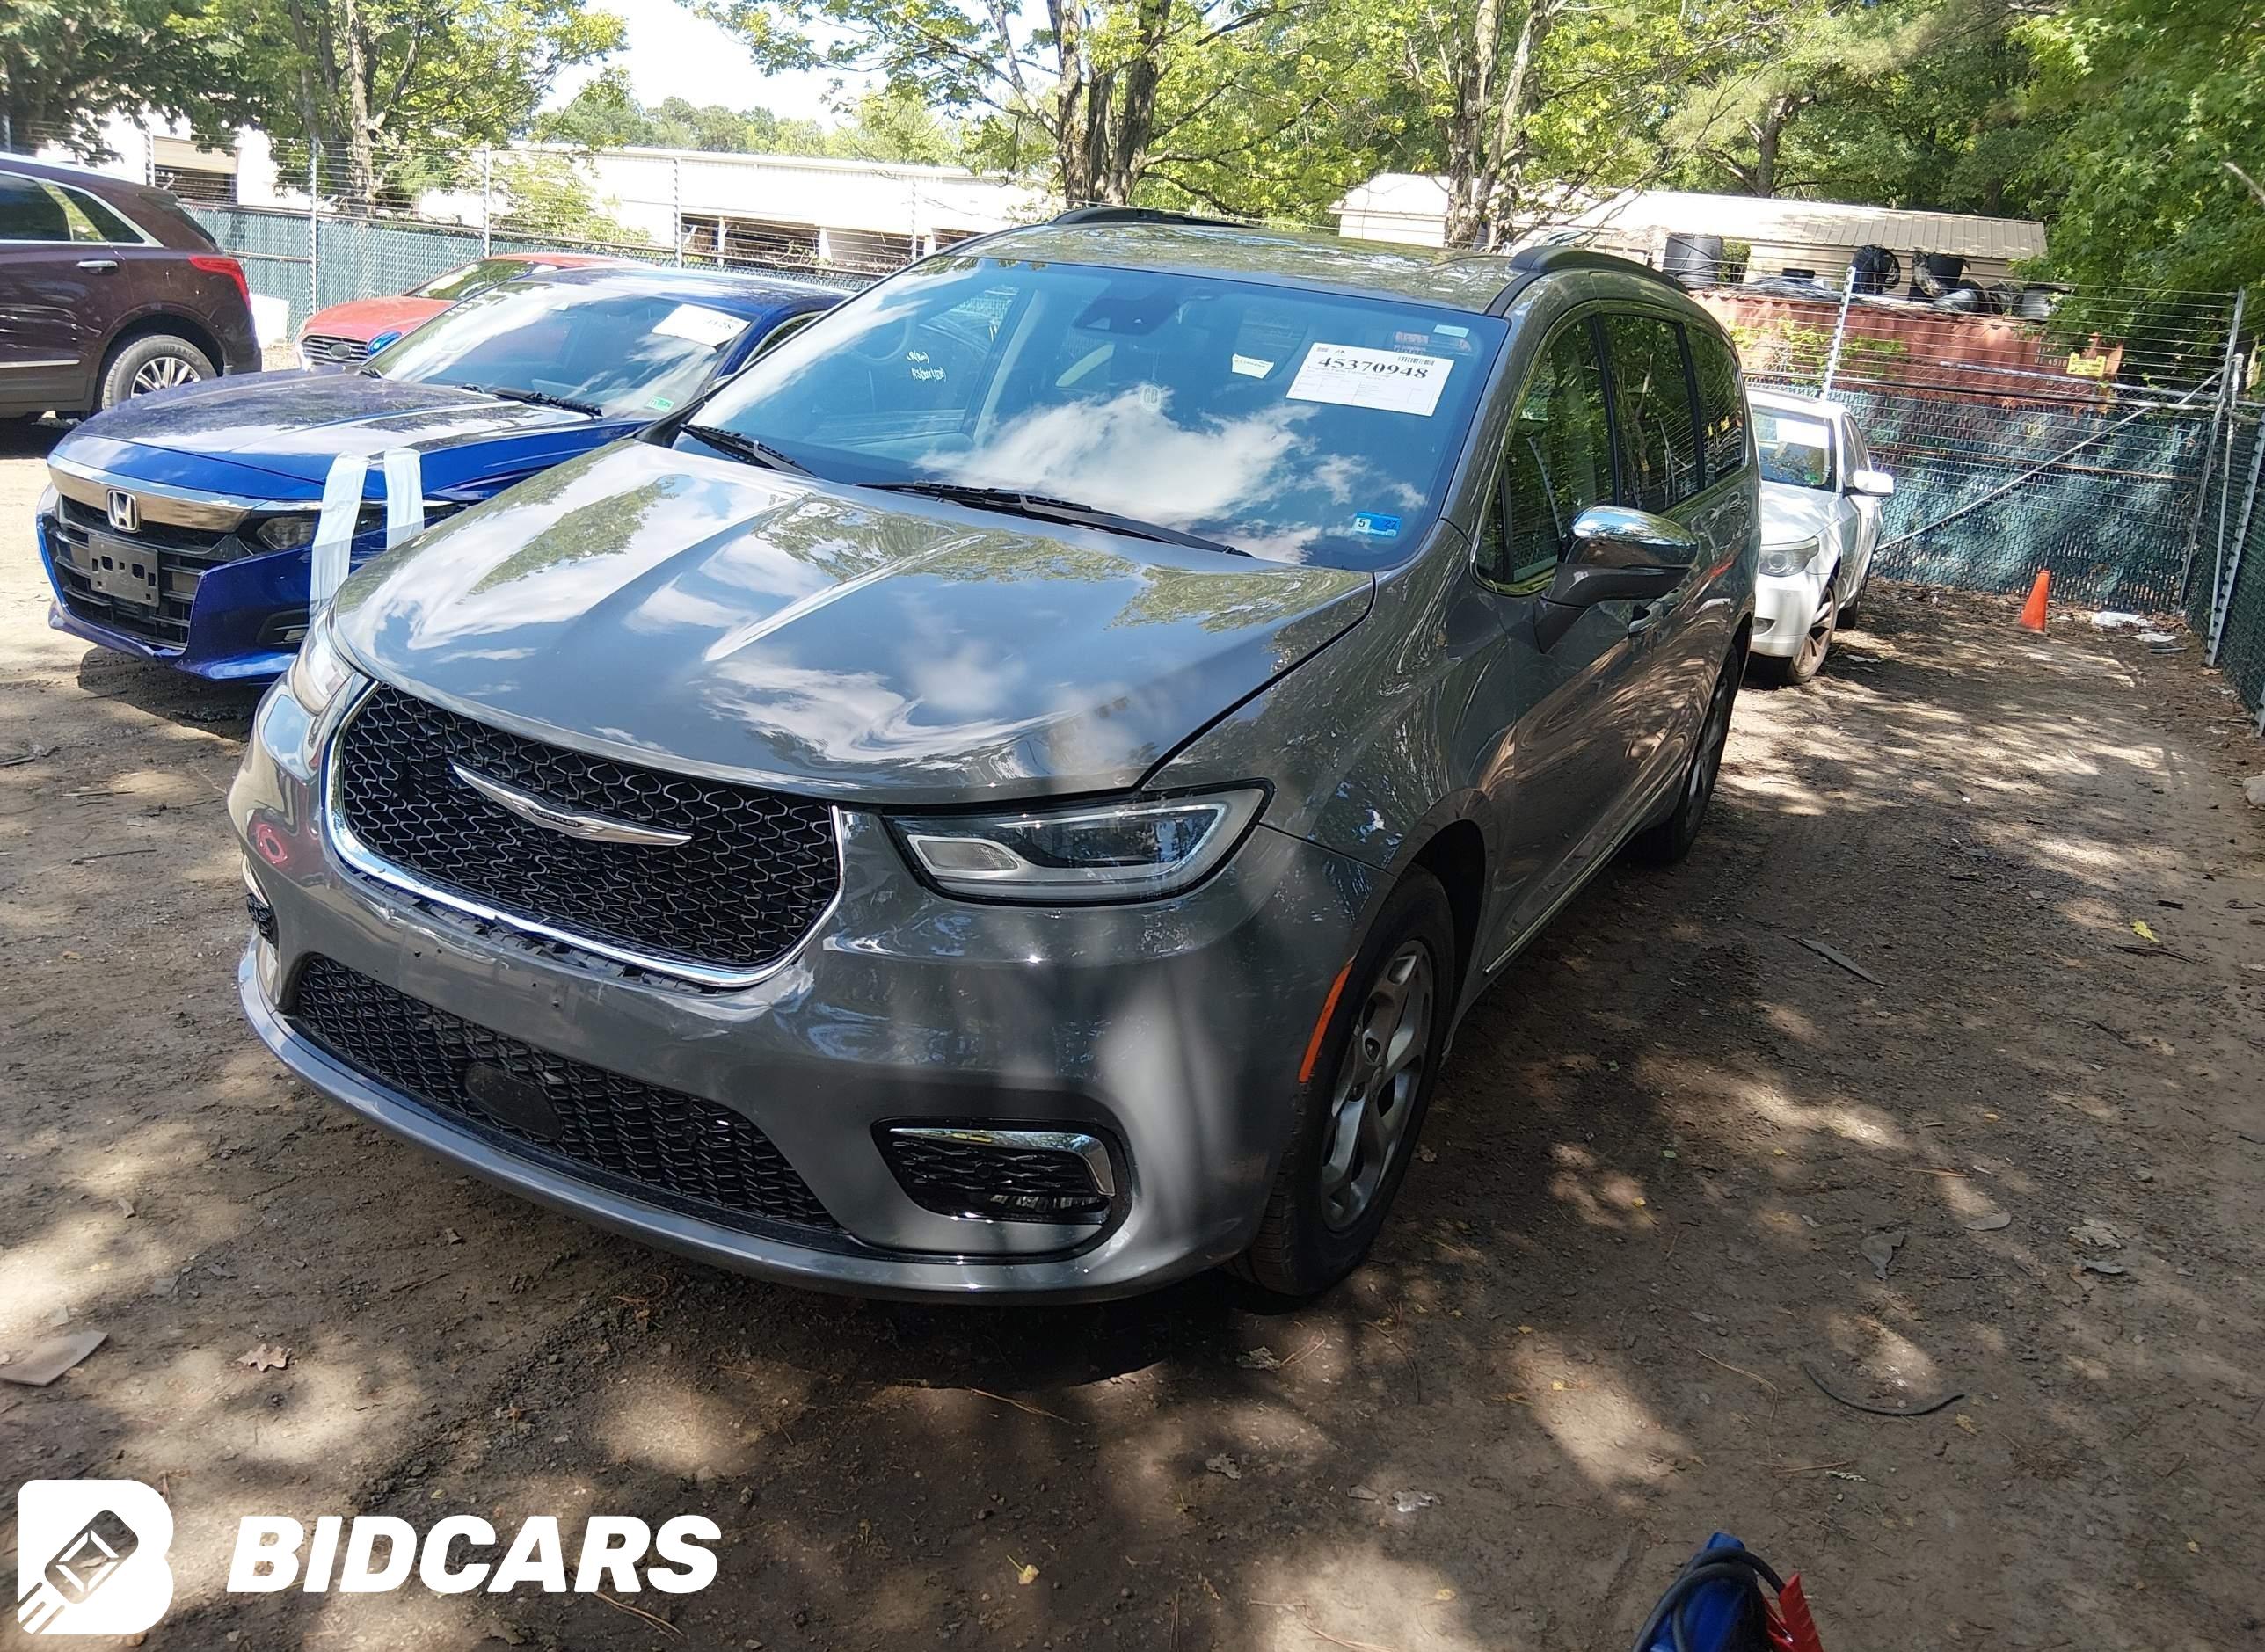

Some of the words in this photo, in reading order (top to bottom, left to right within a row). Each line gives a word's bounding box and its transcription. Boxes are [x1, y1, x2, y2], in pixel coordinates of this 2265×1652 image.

[1317, 356, 1430, 380] 45370948
[1358, 518, 1366, 528] 5
[1384, 520, 1398, 529] 27
[533, 809, 579, 826] CHRYSLER
